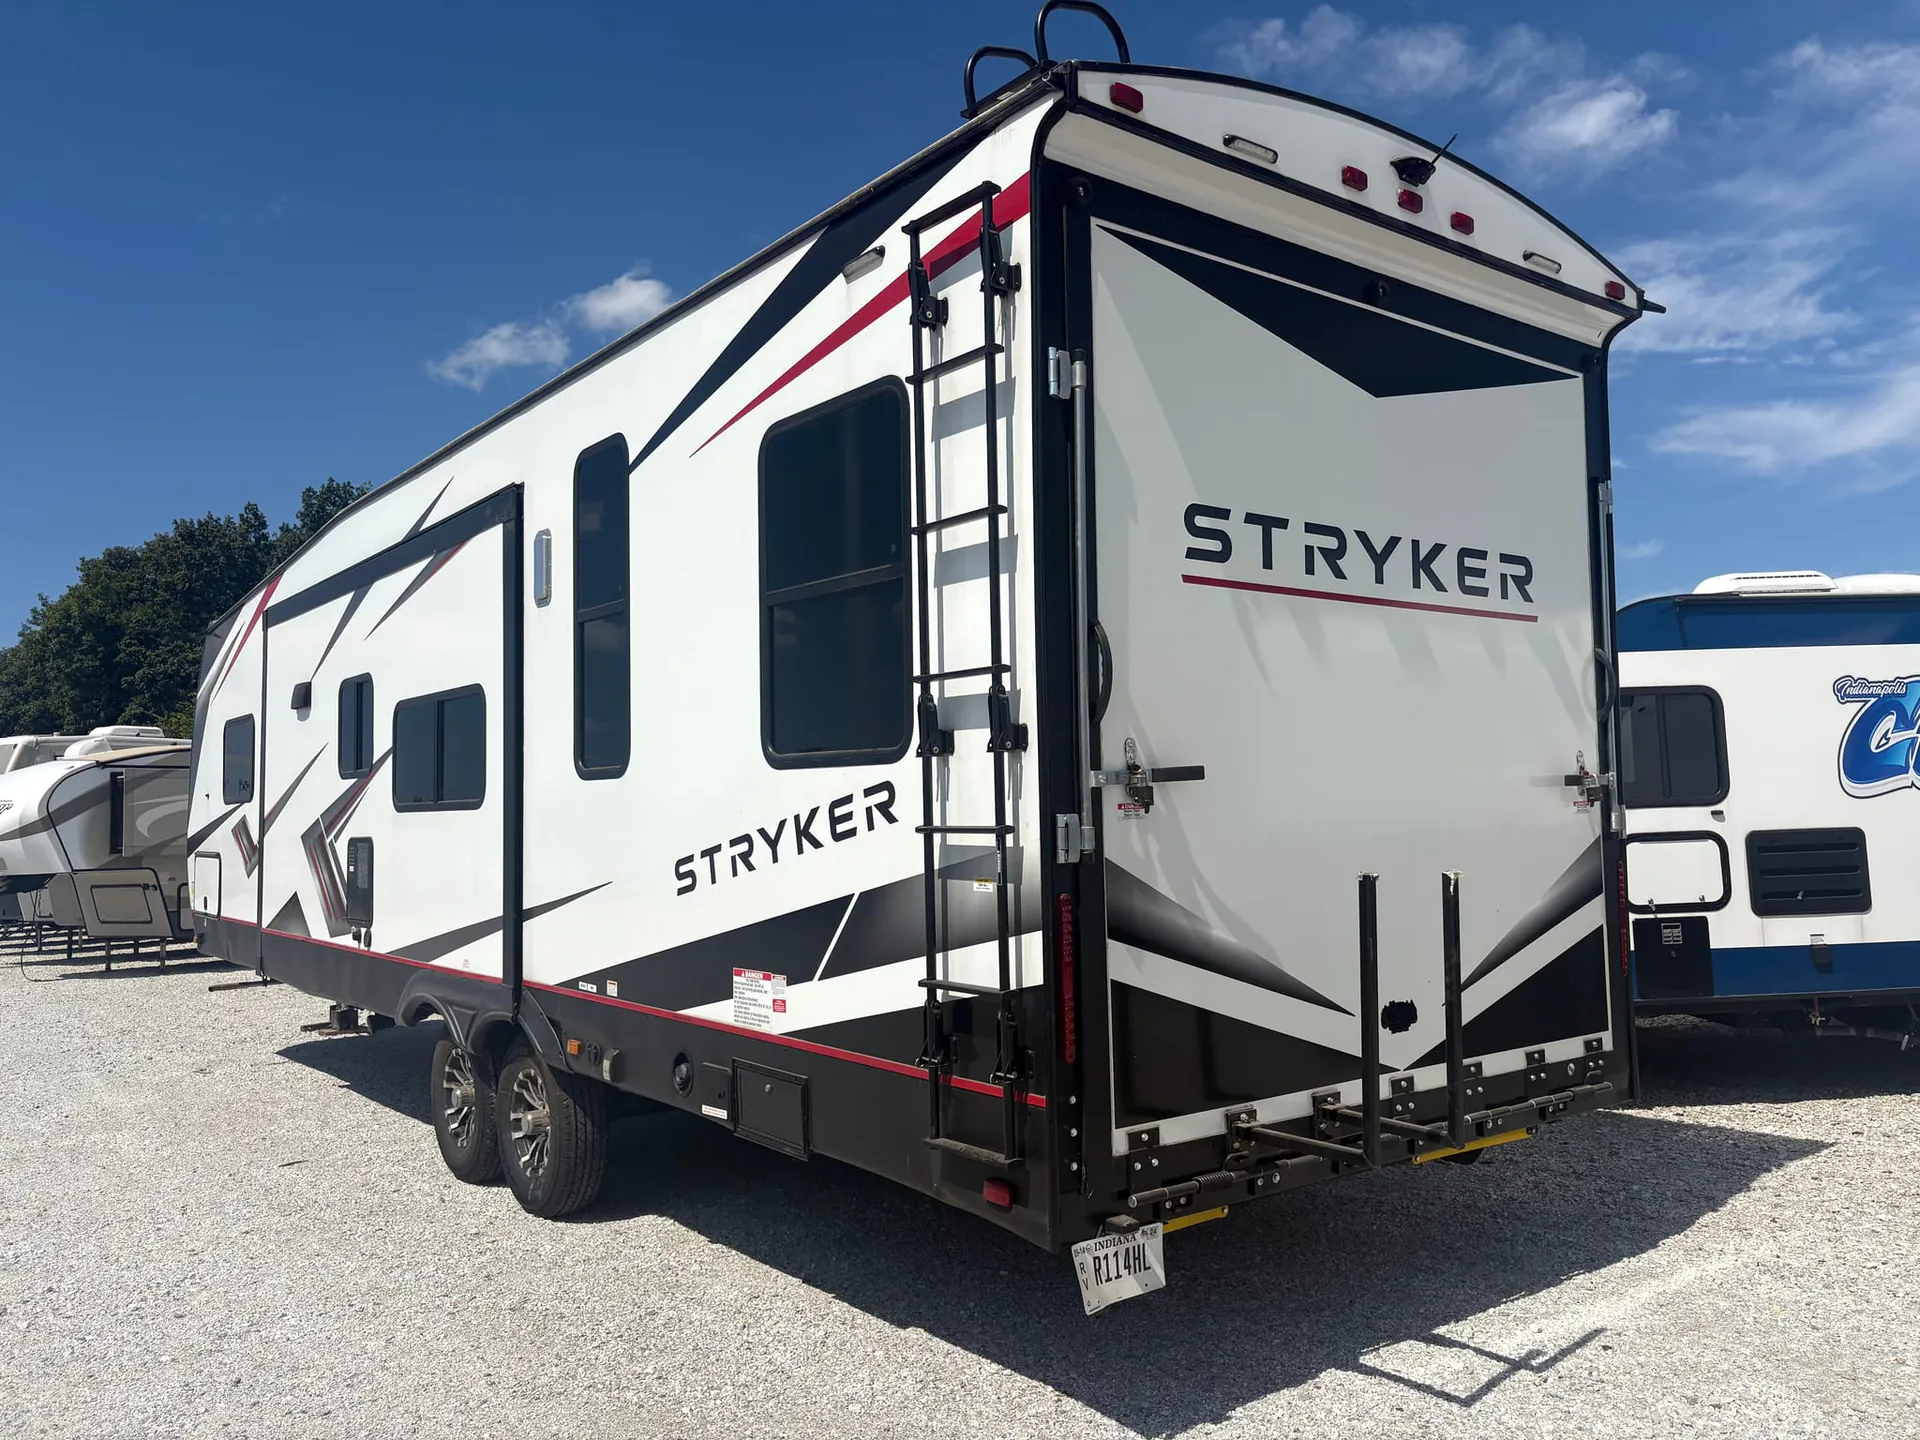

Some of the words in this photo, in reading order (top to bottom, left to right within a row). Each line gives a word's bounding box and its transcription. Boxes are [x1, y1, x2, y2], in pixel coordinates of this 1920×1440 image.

[1184, 502, 1535, 604] STRYKER
[1837, 680, 1908, 698] Indianapolis
[674, 780, 899, 897] STRYKER
[1093, 1242, 1151, 1286] R114HL
[1094, 1233, 1136, 1252] INDIANA
